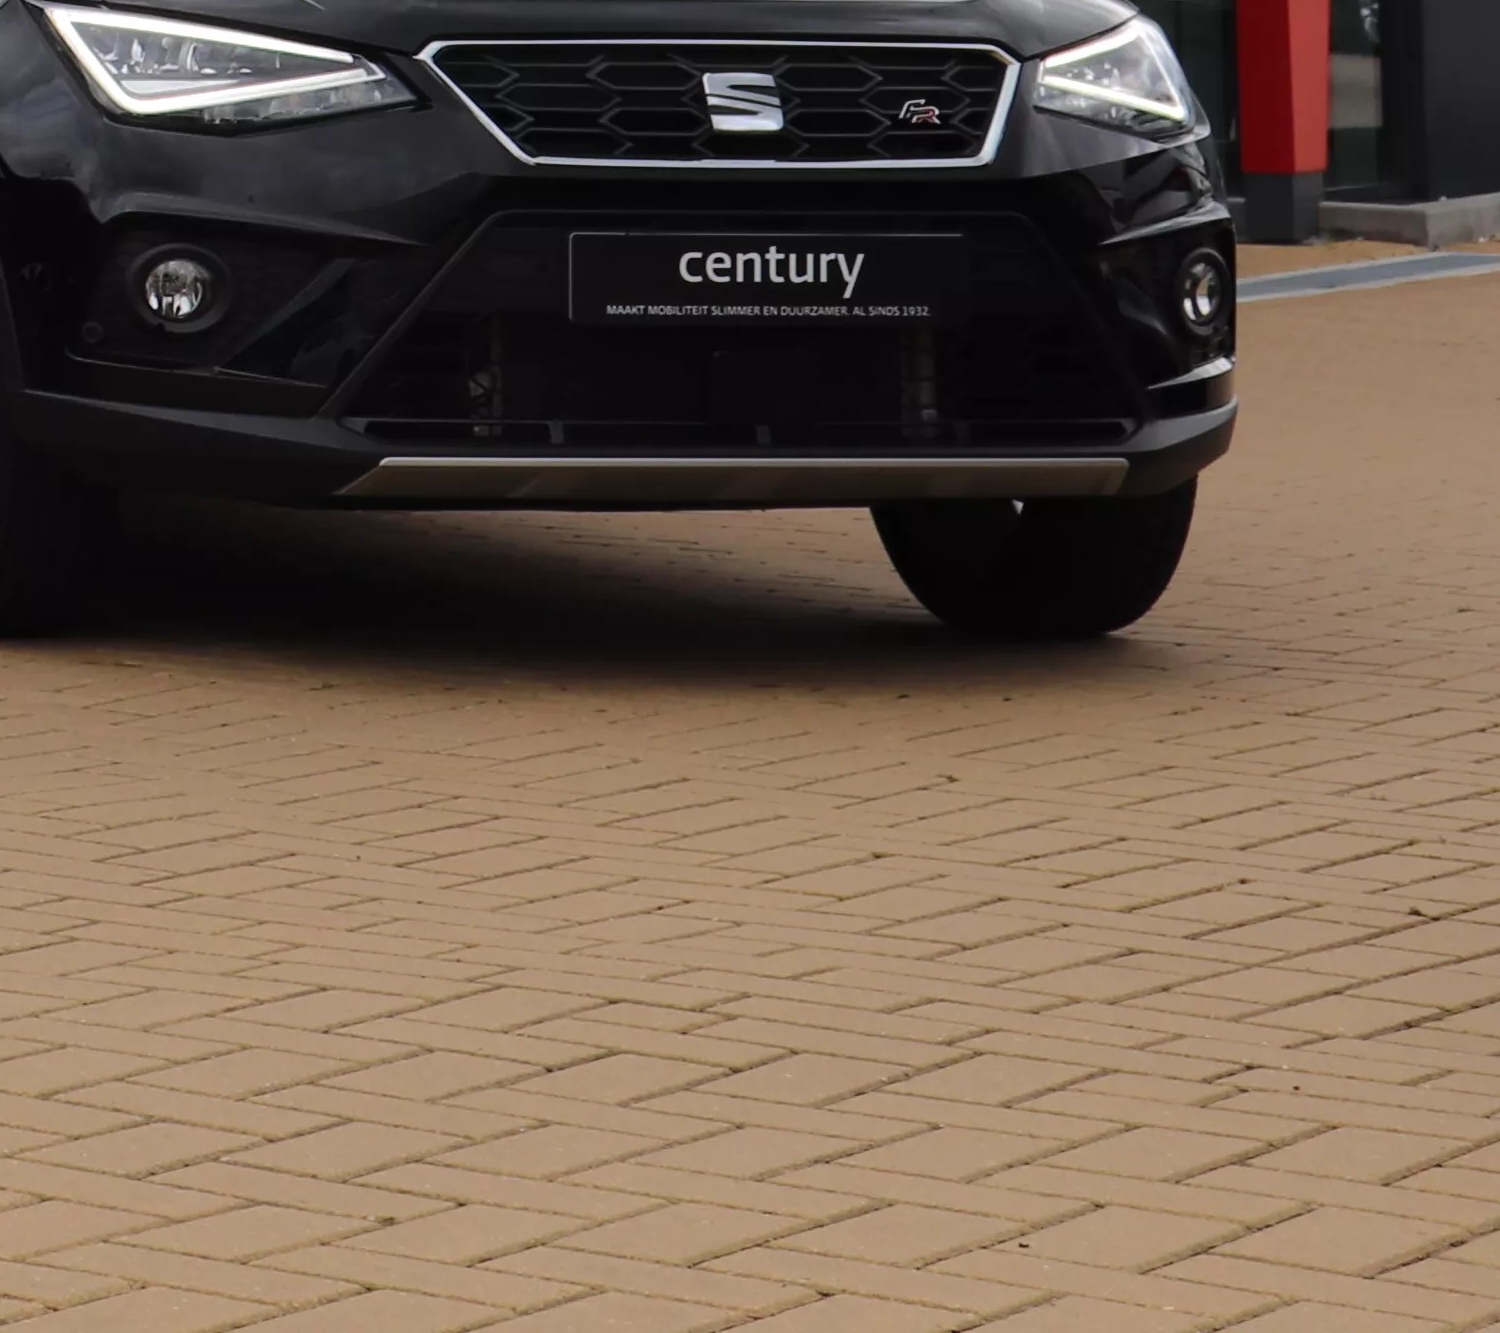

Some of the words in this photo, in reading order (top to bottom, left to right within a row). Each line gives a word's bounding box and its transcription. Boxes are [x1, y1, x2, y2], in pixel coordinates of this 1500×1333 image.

[898, 99, 941, 124] FR
[679, 246, 865, 299] century
[606, 304, 645, 316] MAAKT
[647, 304, 709, 316] MOBILITEIT
[711, 305, 761, 316] SLIMMER
[763, 305, 778, 316] EN
[852, 305, 866, 316] AL
[868, 305, 900, 317] SINDS
